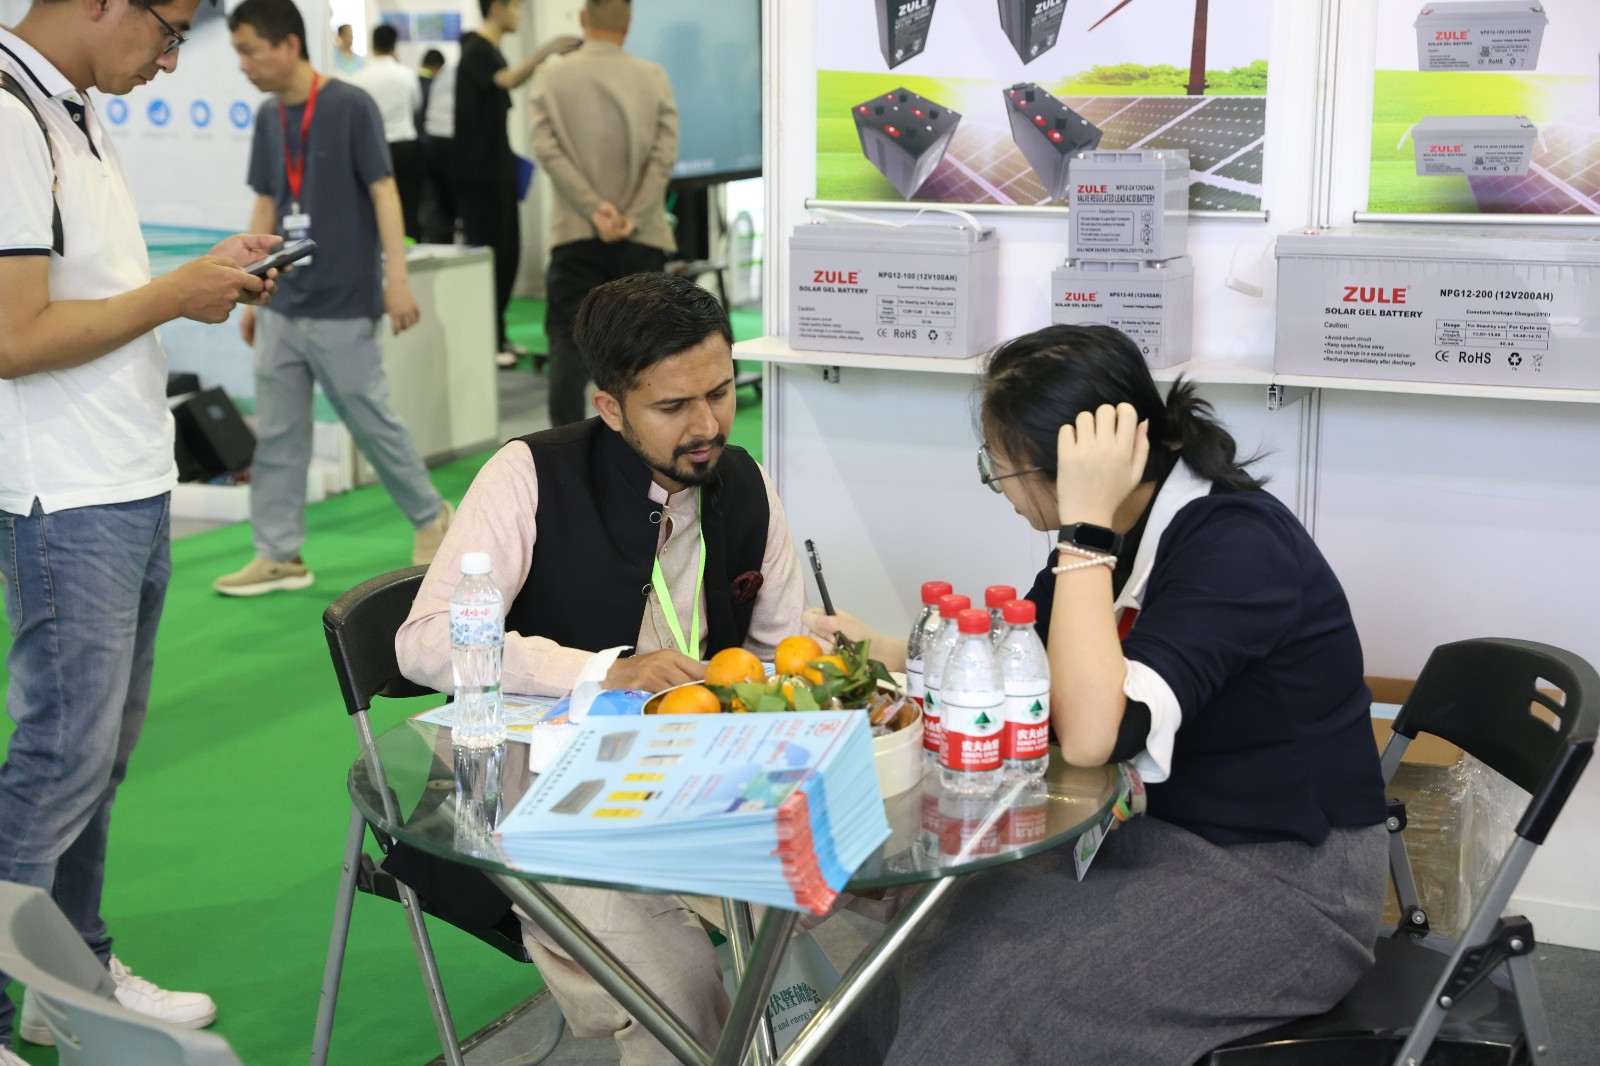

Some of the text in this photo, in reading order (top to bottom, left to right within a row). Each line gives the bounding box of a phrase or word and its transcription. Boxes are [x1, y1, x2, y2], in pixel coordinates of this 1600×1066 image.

[1435, 31, 1467, 40] ZULE
[1430, 145, 1461, 153] ZULE
[1077, 185, 1107, 194] ZULE
[813, 270, 858, 284] ZULE
[917, 273, 957, 282] (12V100AH)
[1065, 292, 1096, 301] ZULE
[1343, 286, 1407, 304] ZULE
[1440, 289, 1554, 302] NPG12-200 (12V200AH)
[1325, 307, 1422, 318] SOLAR GEL BATTERY
[1324, 321, 1350, 329] Caution:
[894, 328, 917, 339] RoHS
[1435, 350, 1492, 364] CE RoHS
[778, 1018, 790, 1031] and
